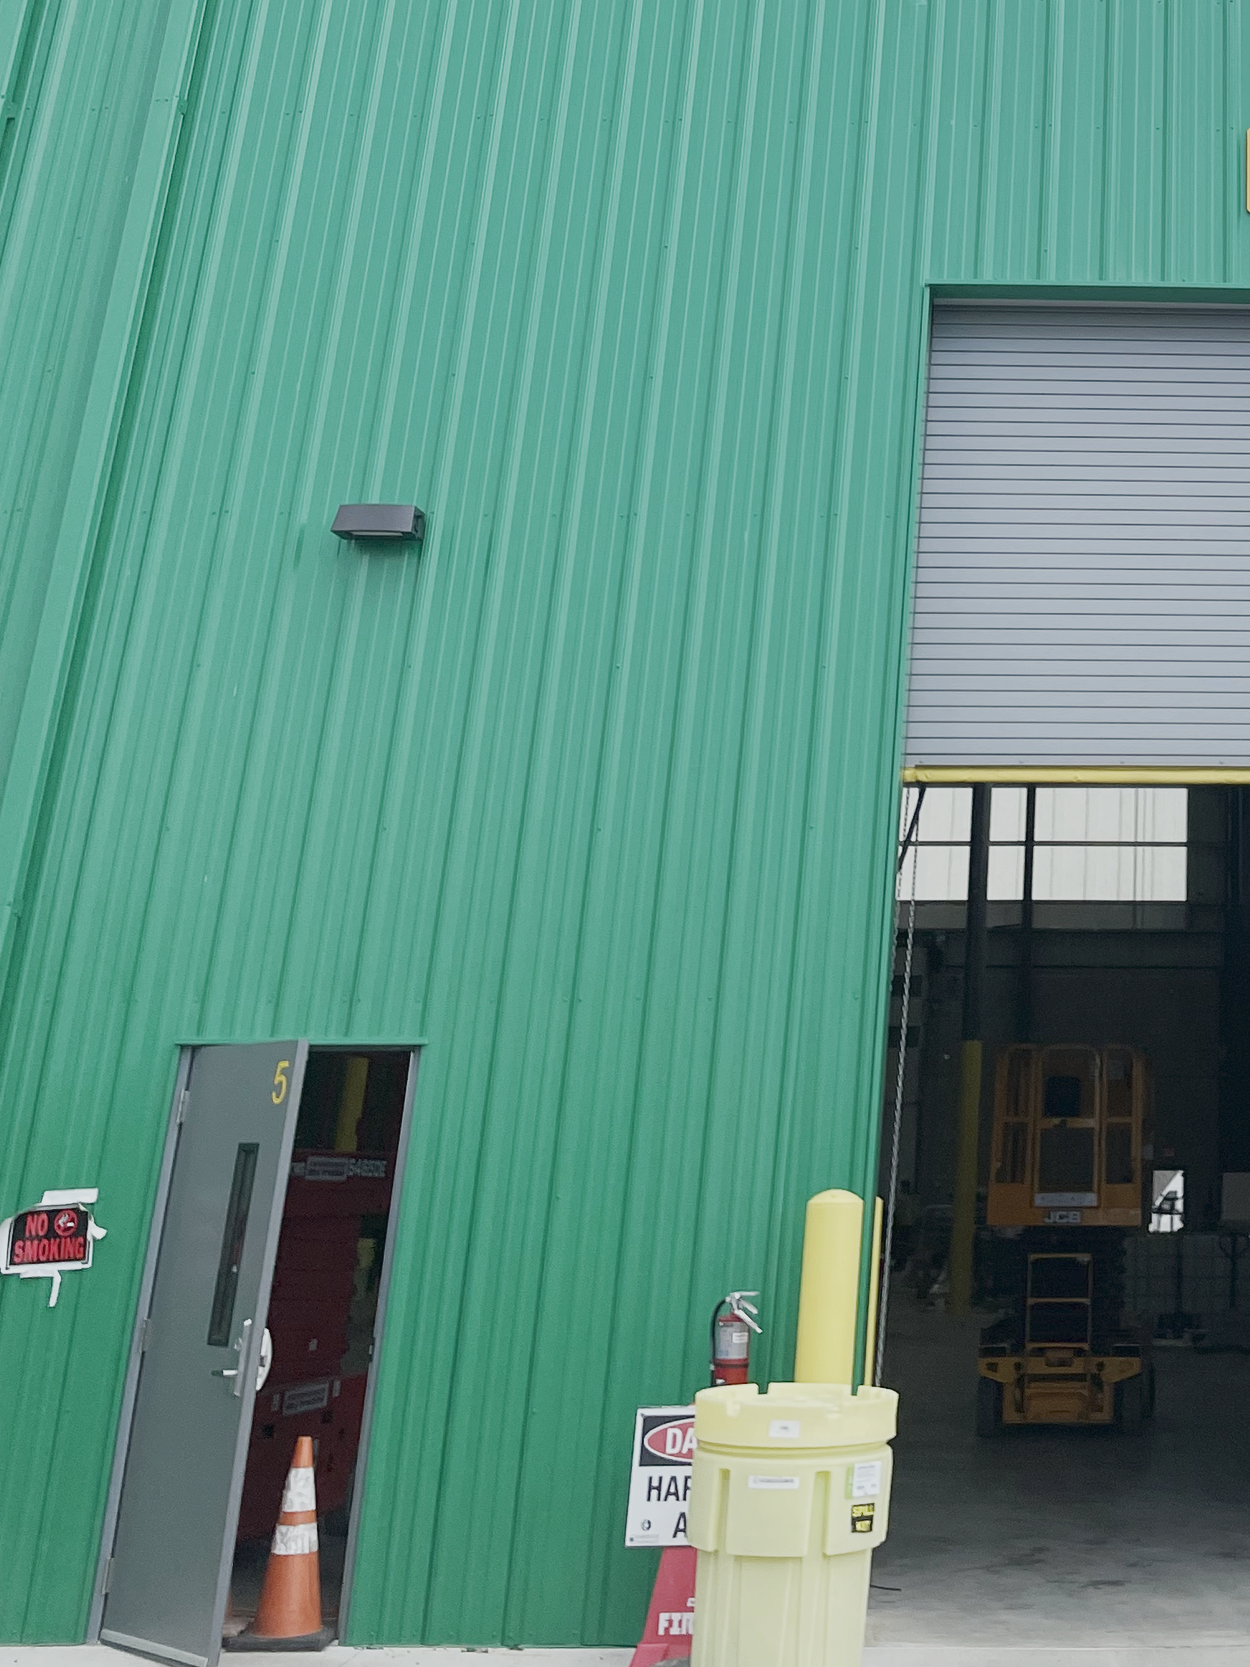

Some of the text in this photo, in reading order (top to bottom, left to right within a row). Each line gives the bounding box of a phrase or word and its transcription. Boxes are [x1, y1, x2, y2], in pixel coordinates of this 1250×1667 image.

[271, 1060, 290, 1105] 5
[25, 1212, 49, 1238] NO
[1044, 1210, 1082, 1224] JCB
[13, 1236, 85, 1264] SMOKING
[665, 1426, 698, 1455] DA
[646, 1475, 692, 1503] HAR
[657, 1611, 695, 1636] FIR
